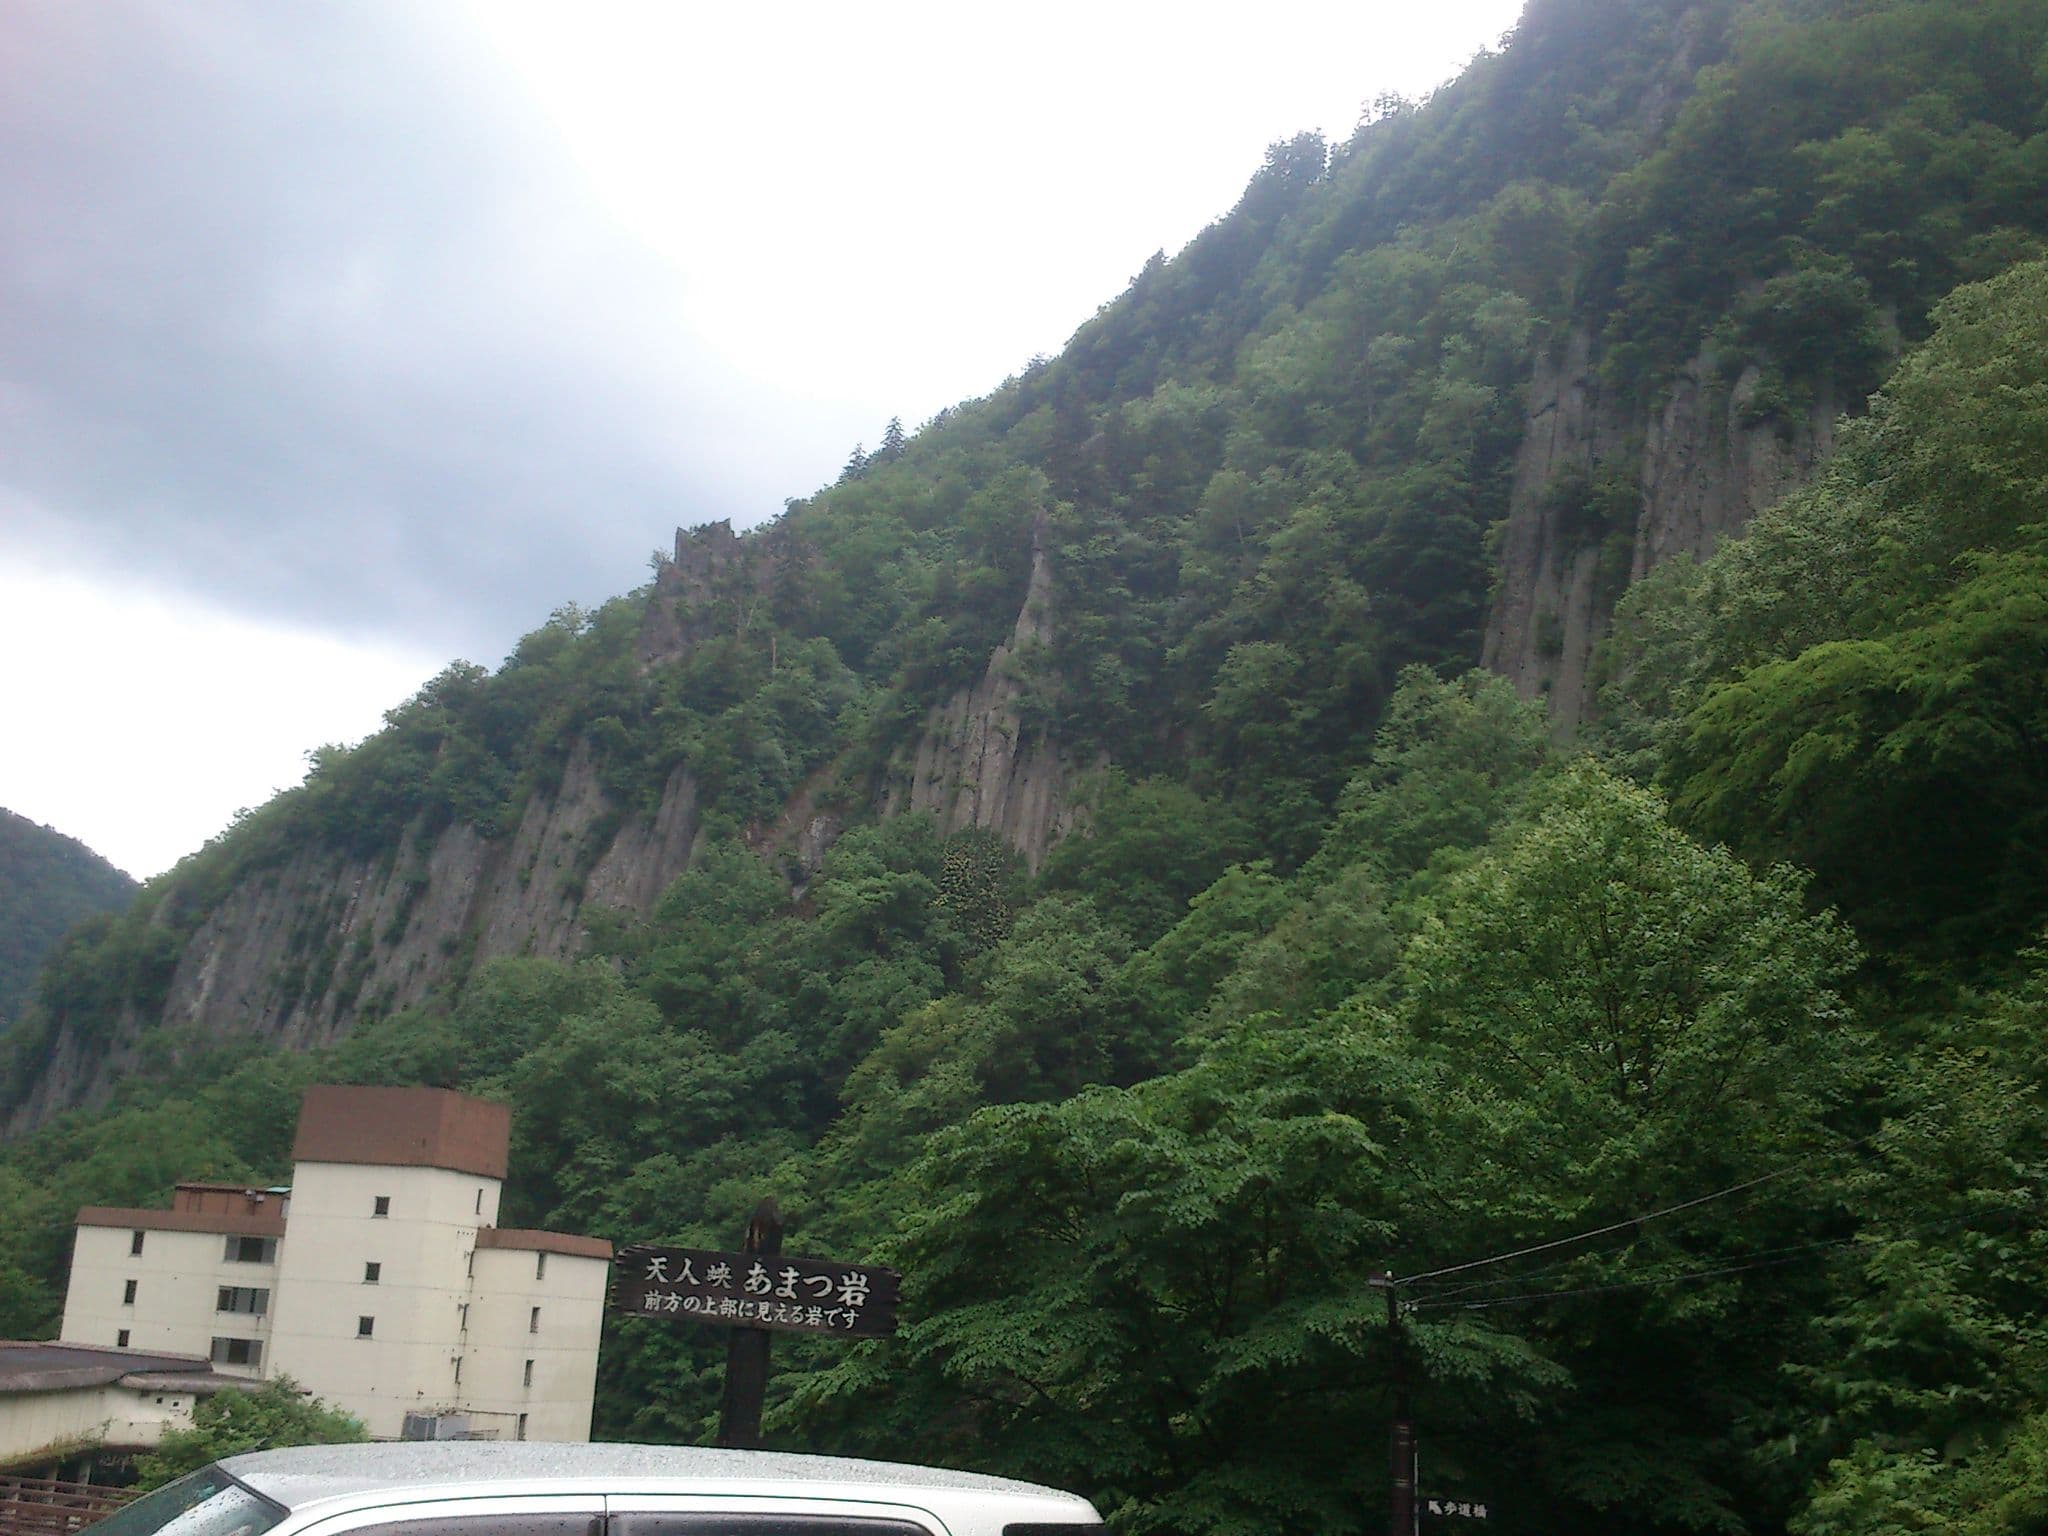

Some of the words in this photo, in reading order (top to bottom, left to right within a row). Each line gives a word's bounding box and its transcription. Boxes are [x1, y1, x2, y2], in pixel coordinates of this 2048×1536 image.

[645, 1257, 734, 1288] 天人峡
[744, 1262, 870, 1306] あまつ岩
[644, 1291, 860, 1328] 前方の上部に見える岩です
